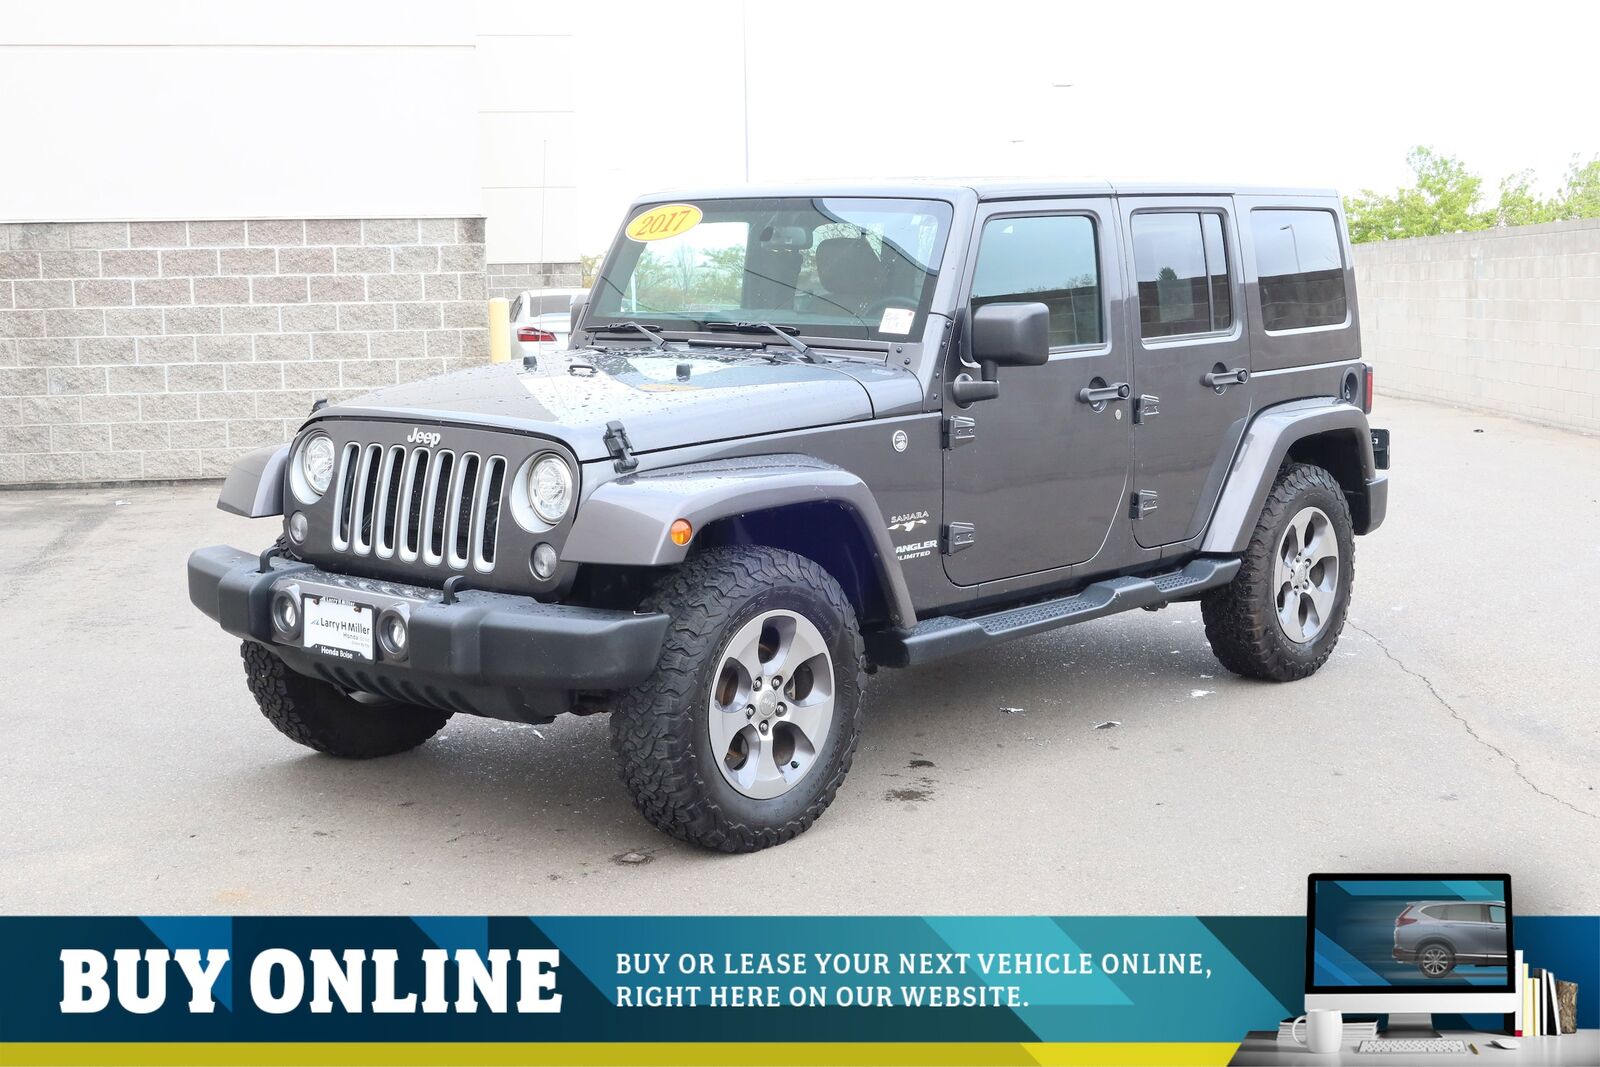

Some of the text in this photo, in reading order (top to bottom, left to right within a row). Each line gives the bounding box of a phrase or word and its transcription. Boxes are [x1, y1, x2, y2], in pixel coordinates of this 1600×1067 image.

[635, 209, 692, 237] 2017
[407, 427, 441, 449] Jeep
[890, 510, 930, 524] SAHARA
[895, 539, 938, 554] ANGLER
[897, 550, 931, 561] LIMITED
[320, 617, 371, 635] Larry H Miller
[320, 645, 339, 657] Honda
